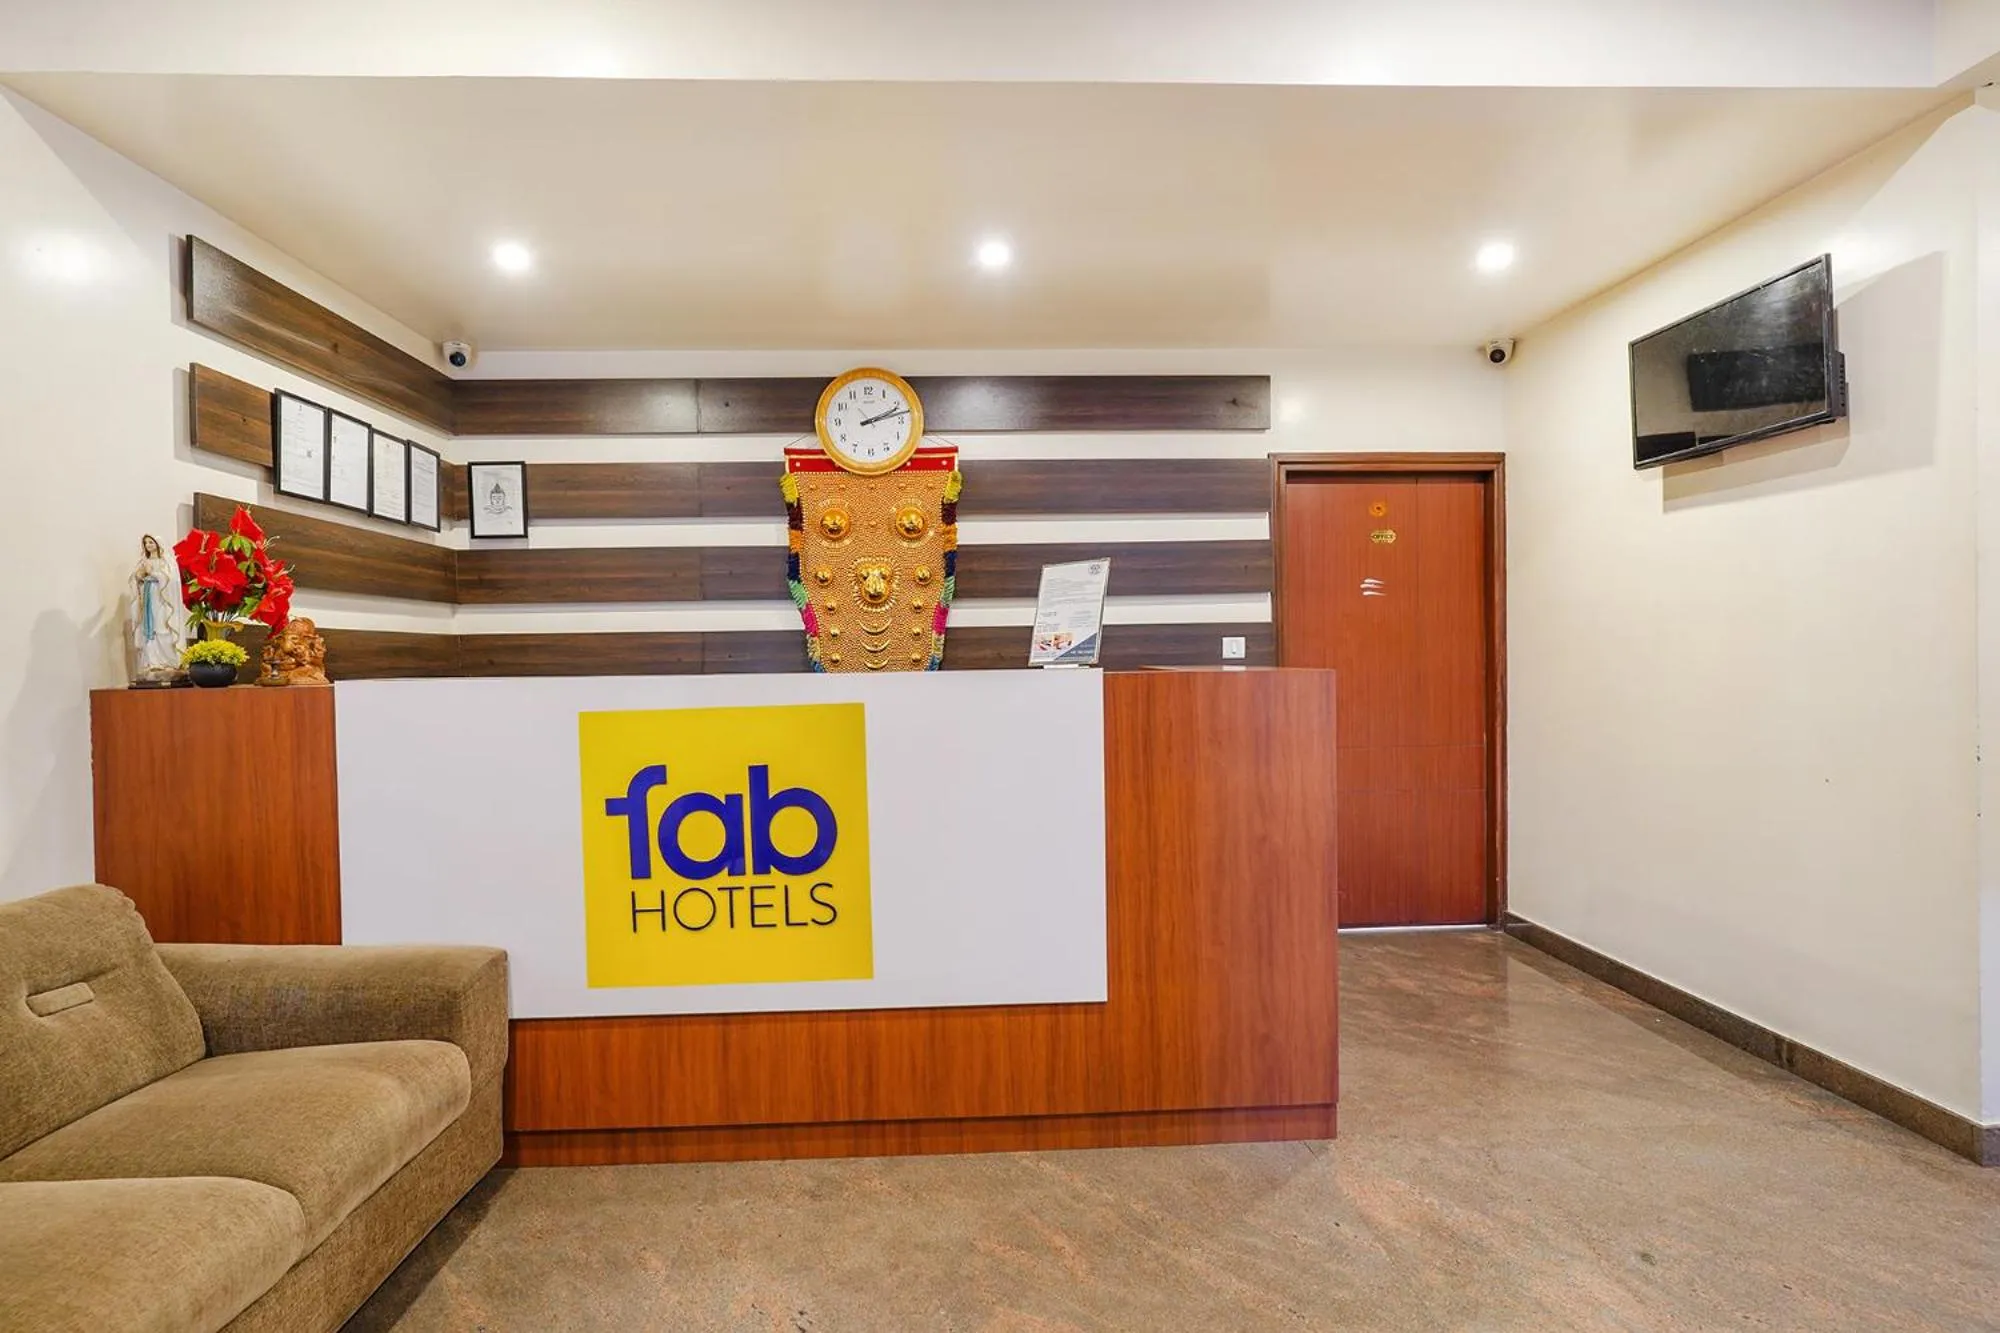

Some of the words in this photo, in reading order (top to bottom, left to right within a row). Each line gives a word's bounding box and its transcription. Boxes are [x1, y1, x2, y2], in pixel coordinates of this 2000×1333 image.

[849, 390, 857, 400] 11
[863, 386, 873, 396] 12
[882, 389, 886, 399] 1
[837, 402, 848, 412] 10
[834, 417, 841, 427] 9
[898, 416, 905, 425] 3
[840, 433, 847, 442] 8
[852, 442, 859, 453] 7
[867, 447, 875, 457] 6
[883, 442, 890, 452] 5
[1372, 533, 1394, 541] OFFICE
[605, 765, 838, 880] fab
[631, 882, 838, 933] HOTELS
